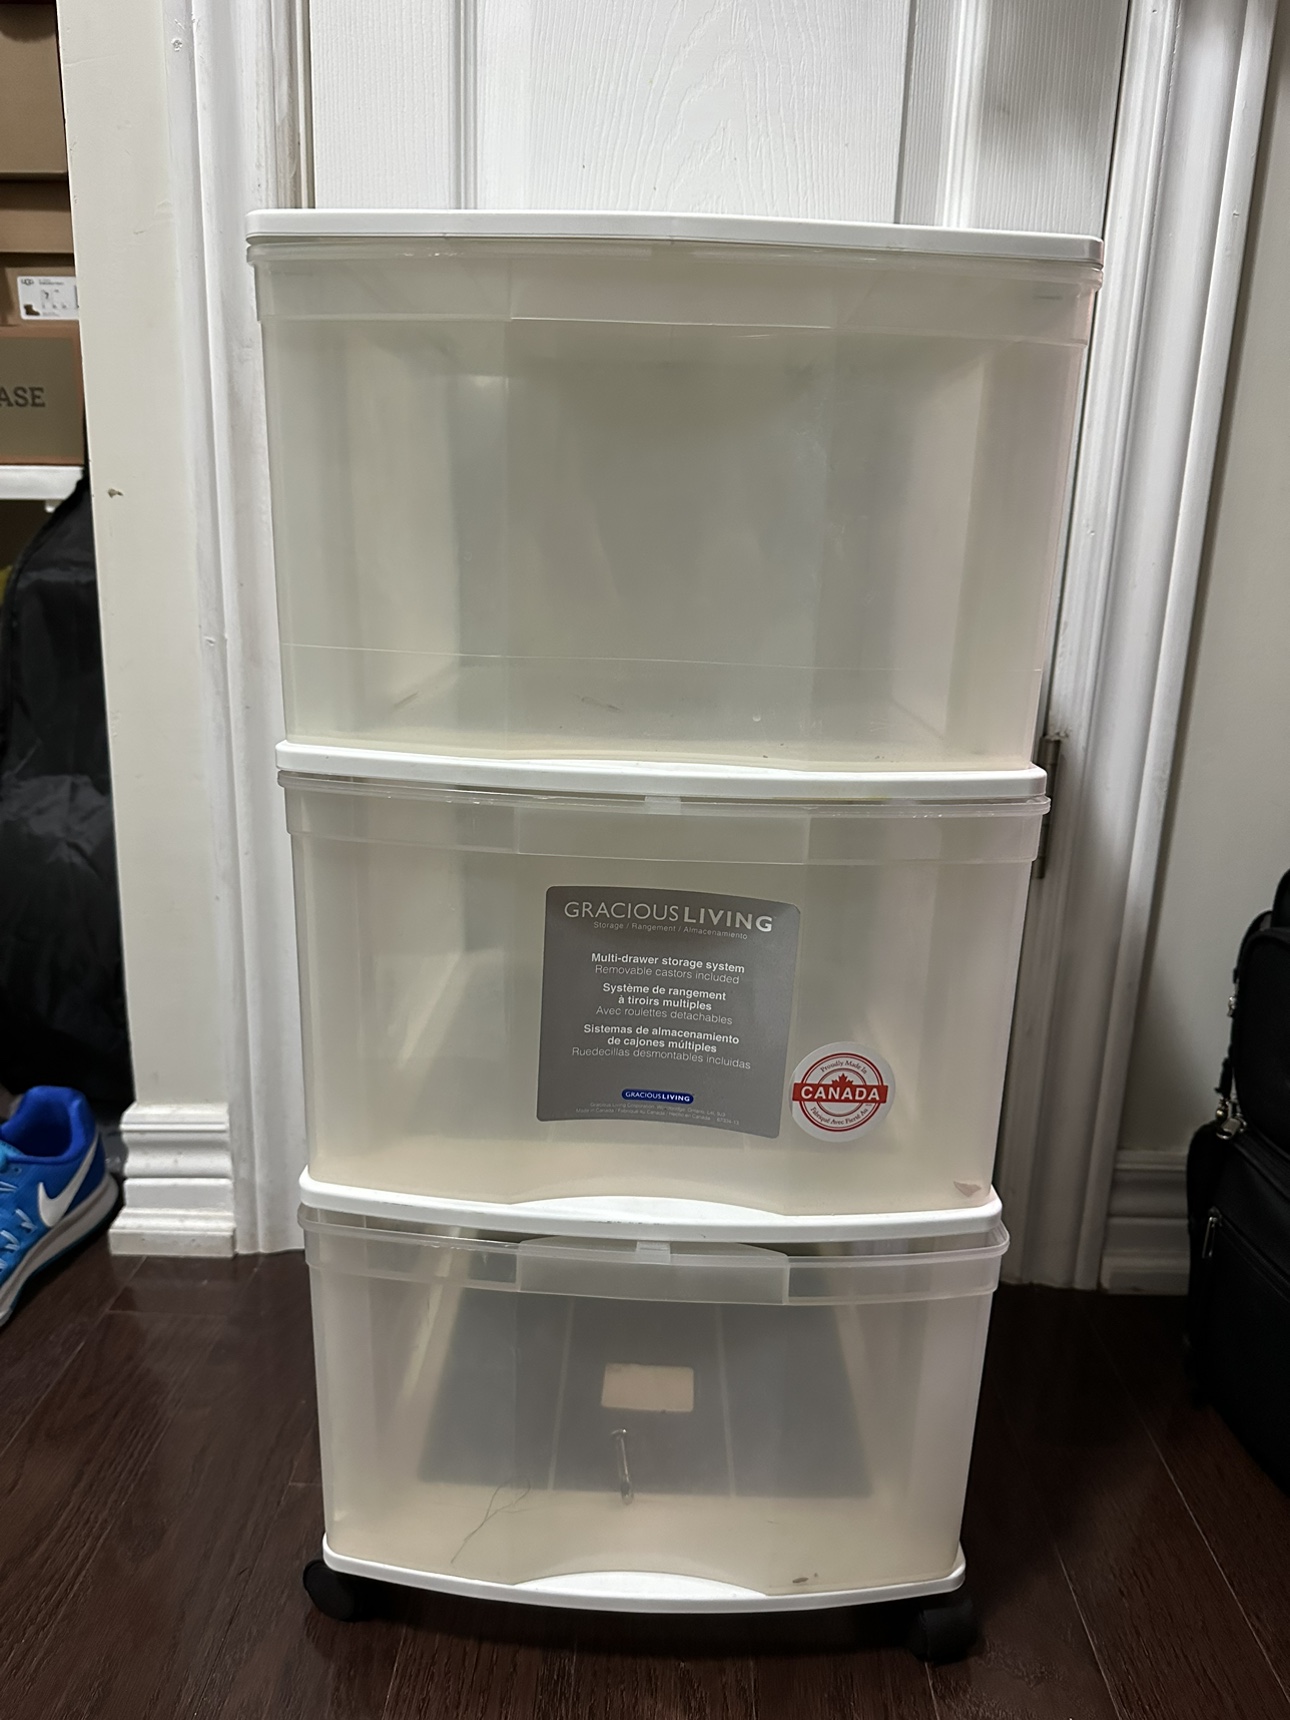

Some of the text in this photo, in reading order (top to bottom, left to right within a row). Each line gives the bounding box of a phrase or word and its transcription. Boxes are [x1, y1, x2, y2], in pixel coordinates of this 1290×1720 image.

[593, 921, 624, 929] Storage
[631, 922, 676, 932] Rangement
[683, 926, 748, 940] Almacenamiento
[591, 952, 745, 974] Multi-drawer storage system
[595, 964, 740, 984] Removable castors included
[602, 982, 726, 1001] Système de rangement
[595, 1006, 622, 1016] Avec
[624, 1007, 667, 1018] roulettes
[618, 995, 712, 1011] à tiroirs multiples
[583, 1024, 740, 1044] Sistemas de almacenamiento
[607, 1036, 717, 1053] de cajones múltiples
[572, 1046, 751, 1070] Ruedecillas desmontables incluidas
[820, 1060, 844, 1073] Proudly
[844, 1060, 861, 1070] Made
[801, 1086, 880, 1101] CANADA
[830, 1117, 844, 1125] Avec
